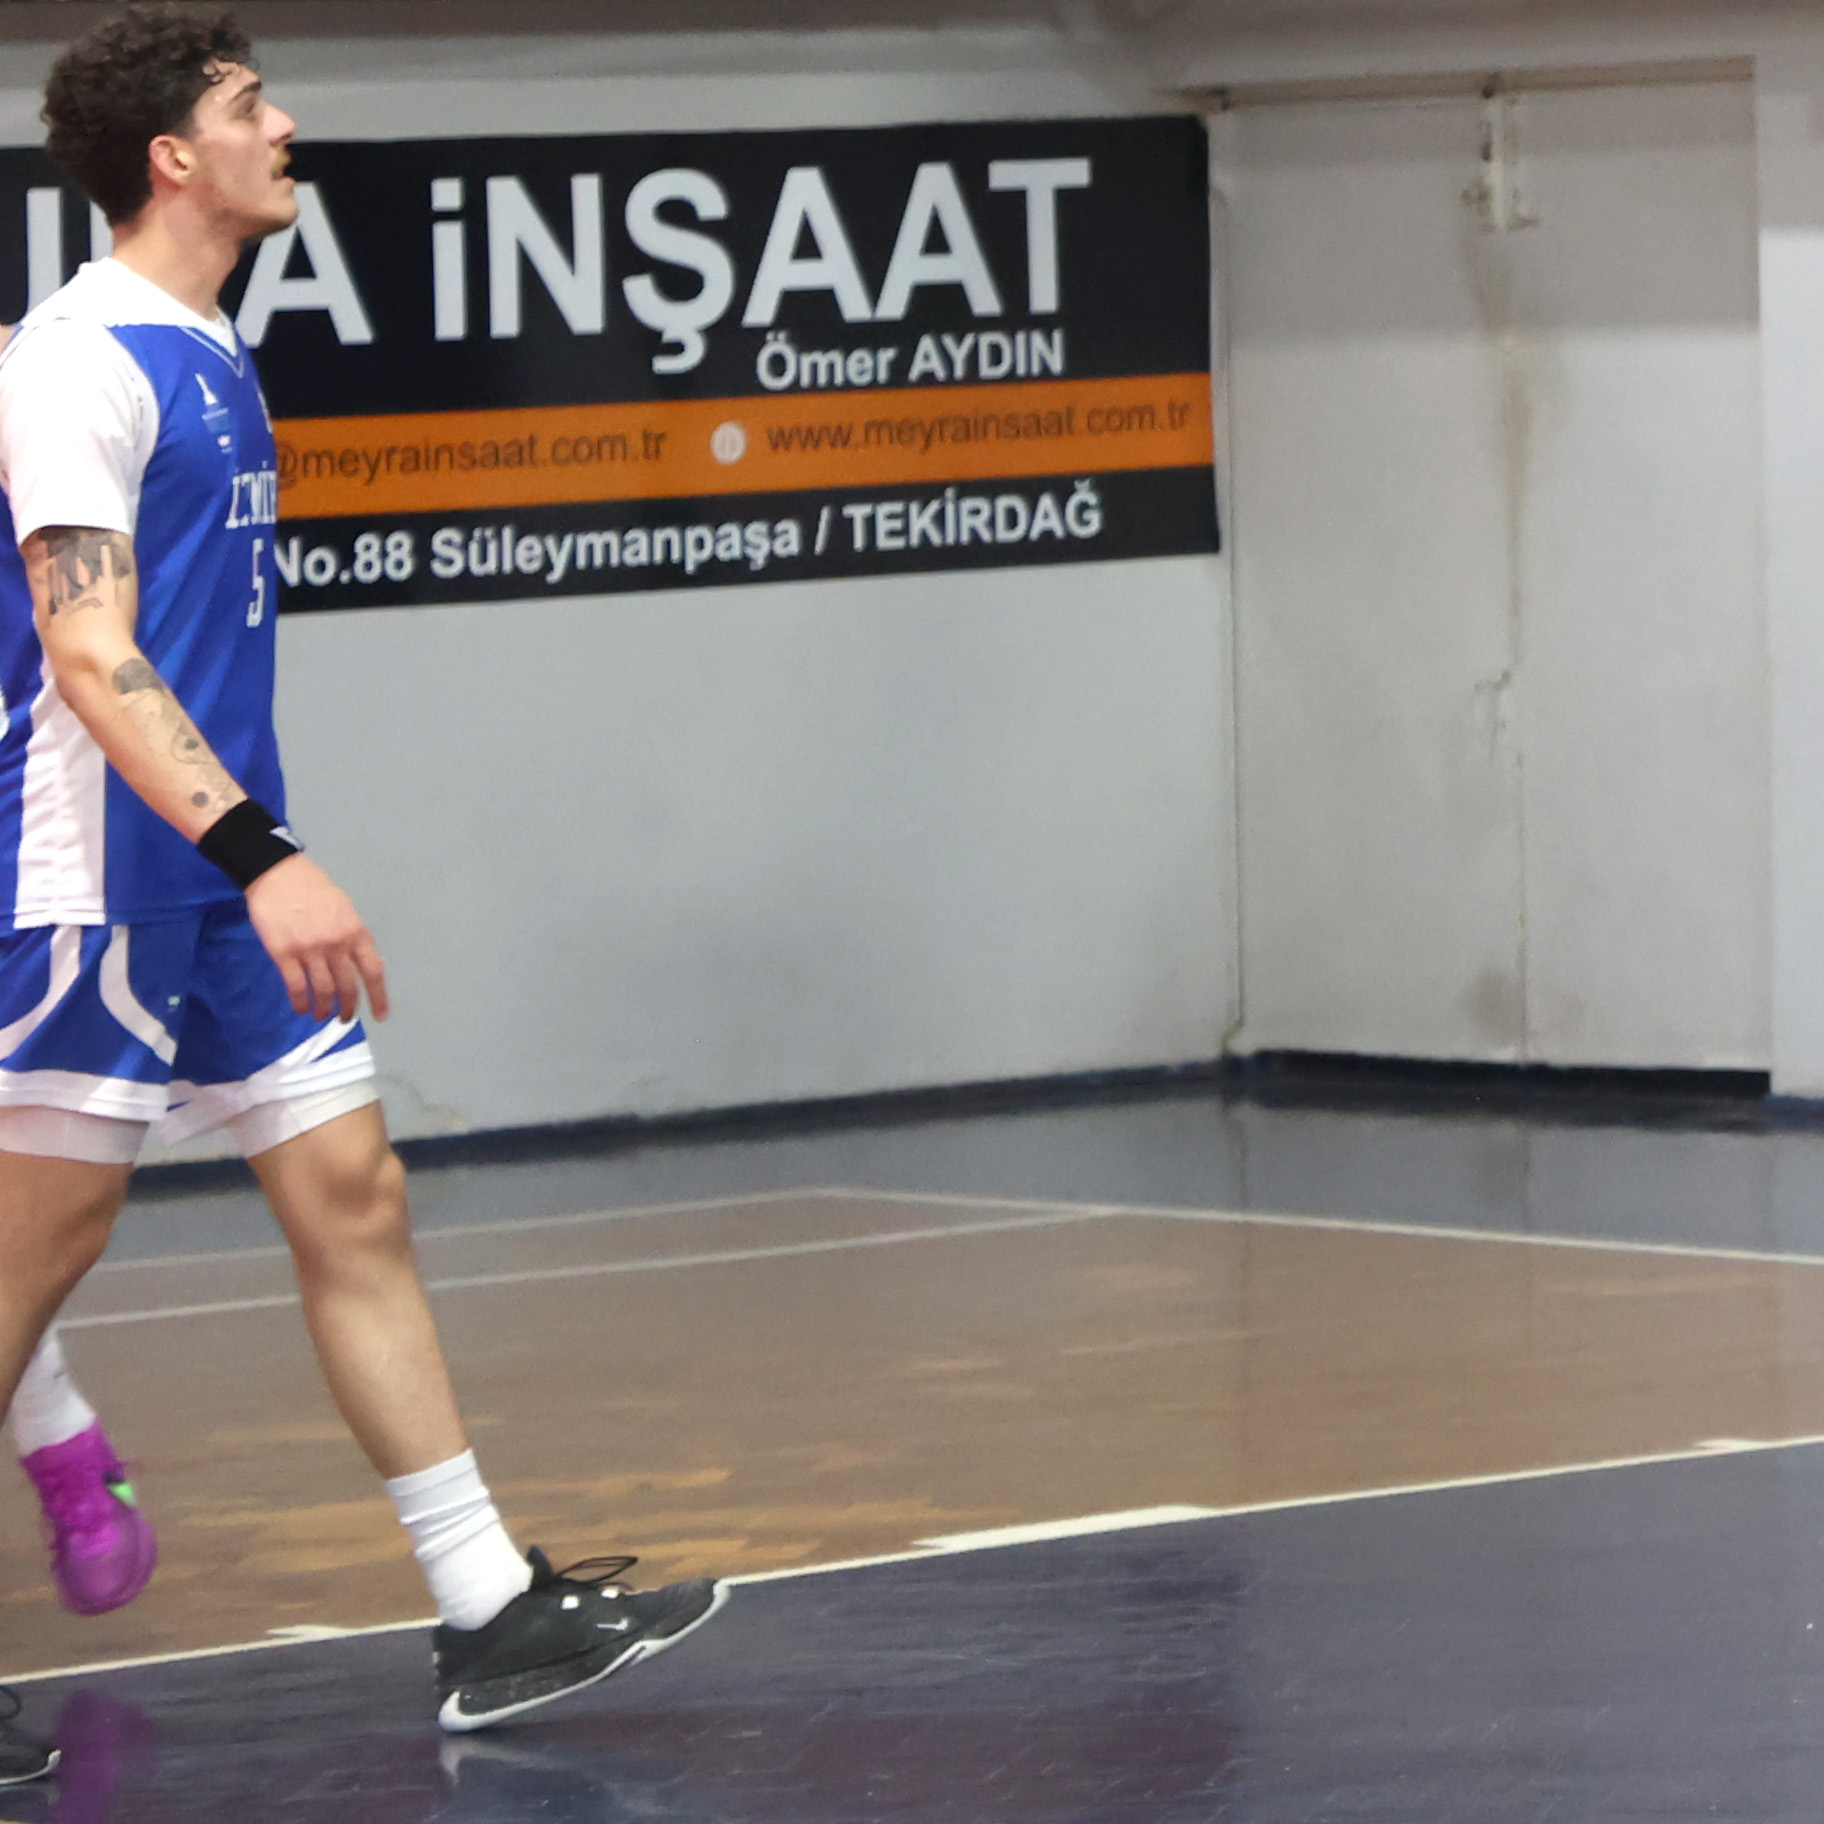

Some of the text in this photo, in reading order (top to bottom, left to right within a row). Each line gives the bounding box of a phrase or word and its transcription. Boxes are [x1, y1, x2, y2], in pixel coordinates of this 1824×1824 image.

[756, 327, 1065, 391] Ömer AYDIN
[766, 397, 1191, 455] www.meyrainsaat.com.tr
[430, 516, 802, 584] Süleymanpaşa
[842, 477, 1104, 553] TEKİRDAĞ
[245, 537, 266, 628] 5
